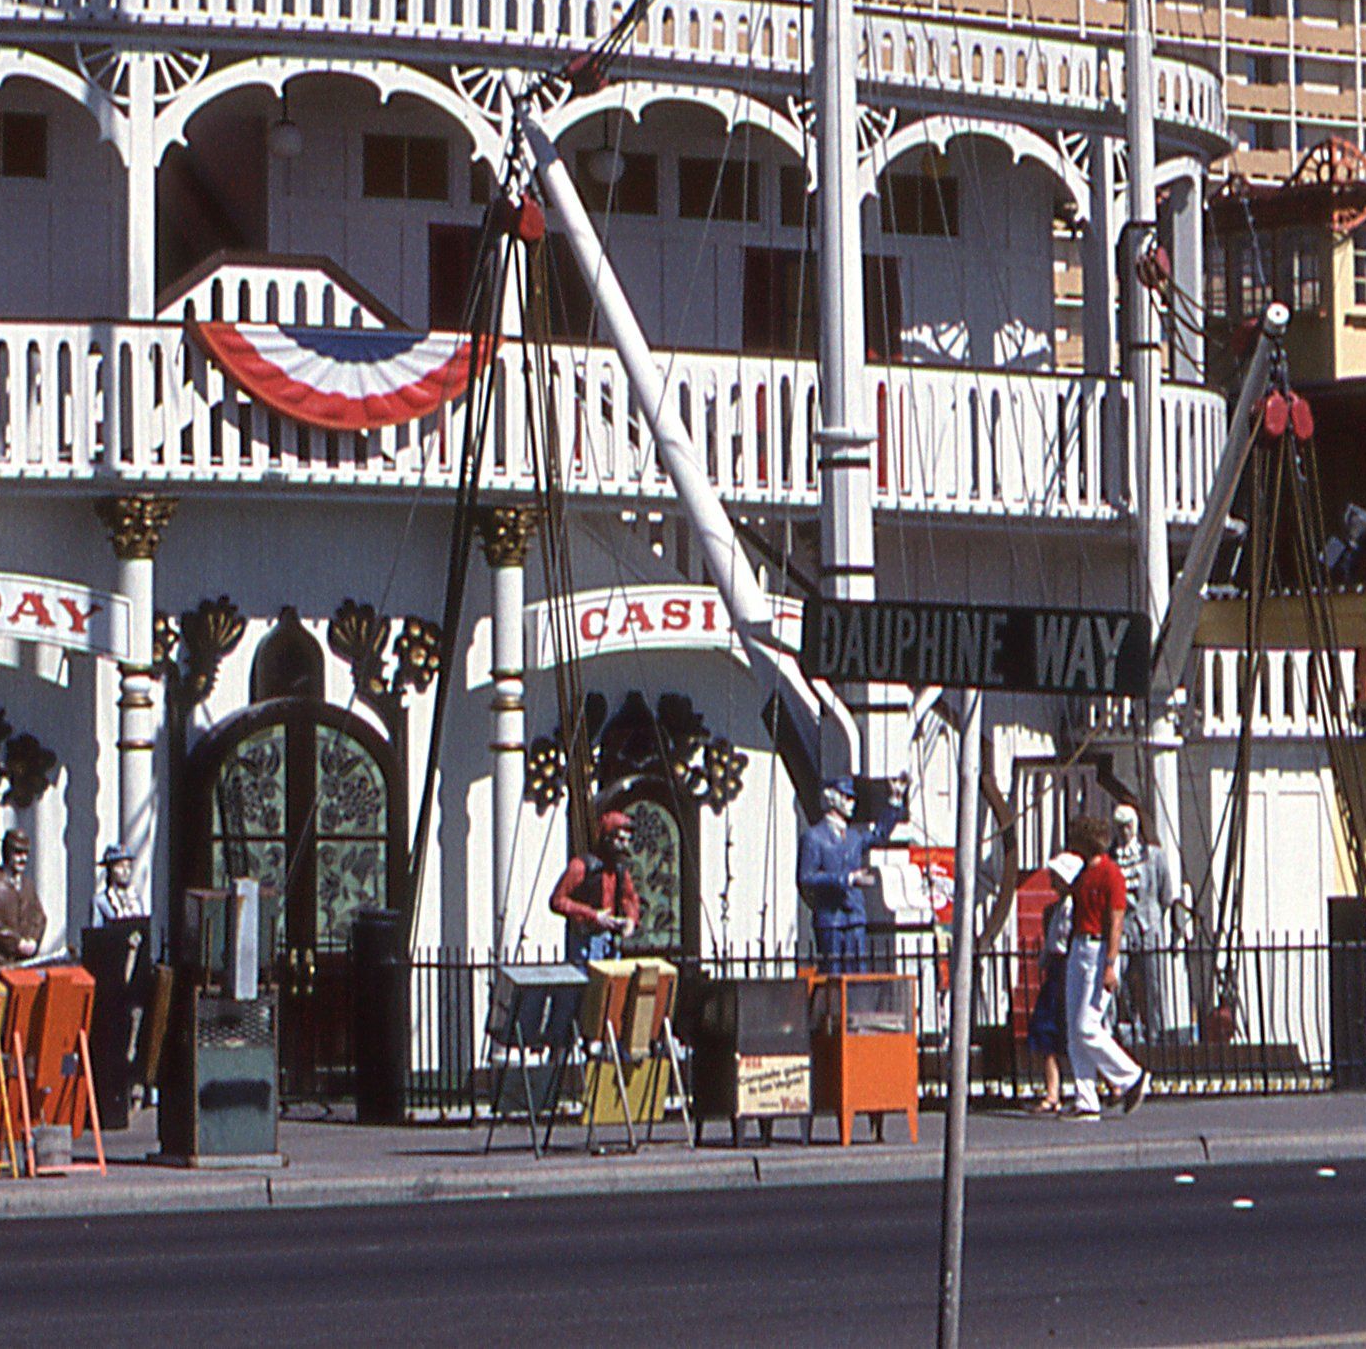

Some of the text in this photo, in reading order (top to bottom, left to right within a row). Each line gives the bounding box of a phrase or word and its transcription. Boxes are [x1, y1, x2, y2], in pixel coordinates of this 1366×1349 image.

[580, 598, 802, 641] CASI
[818, 605, 1130, 690] DAUPHINE WAY
